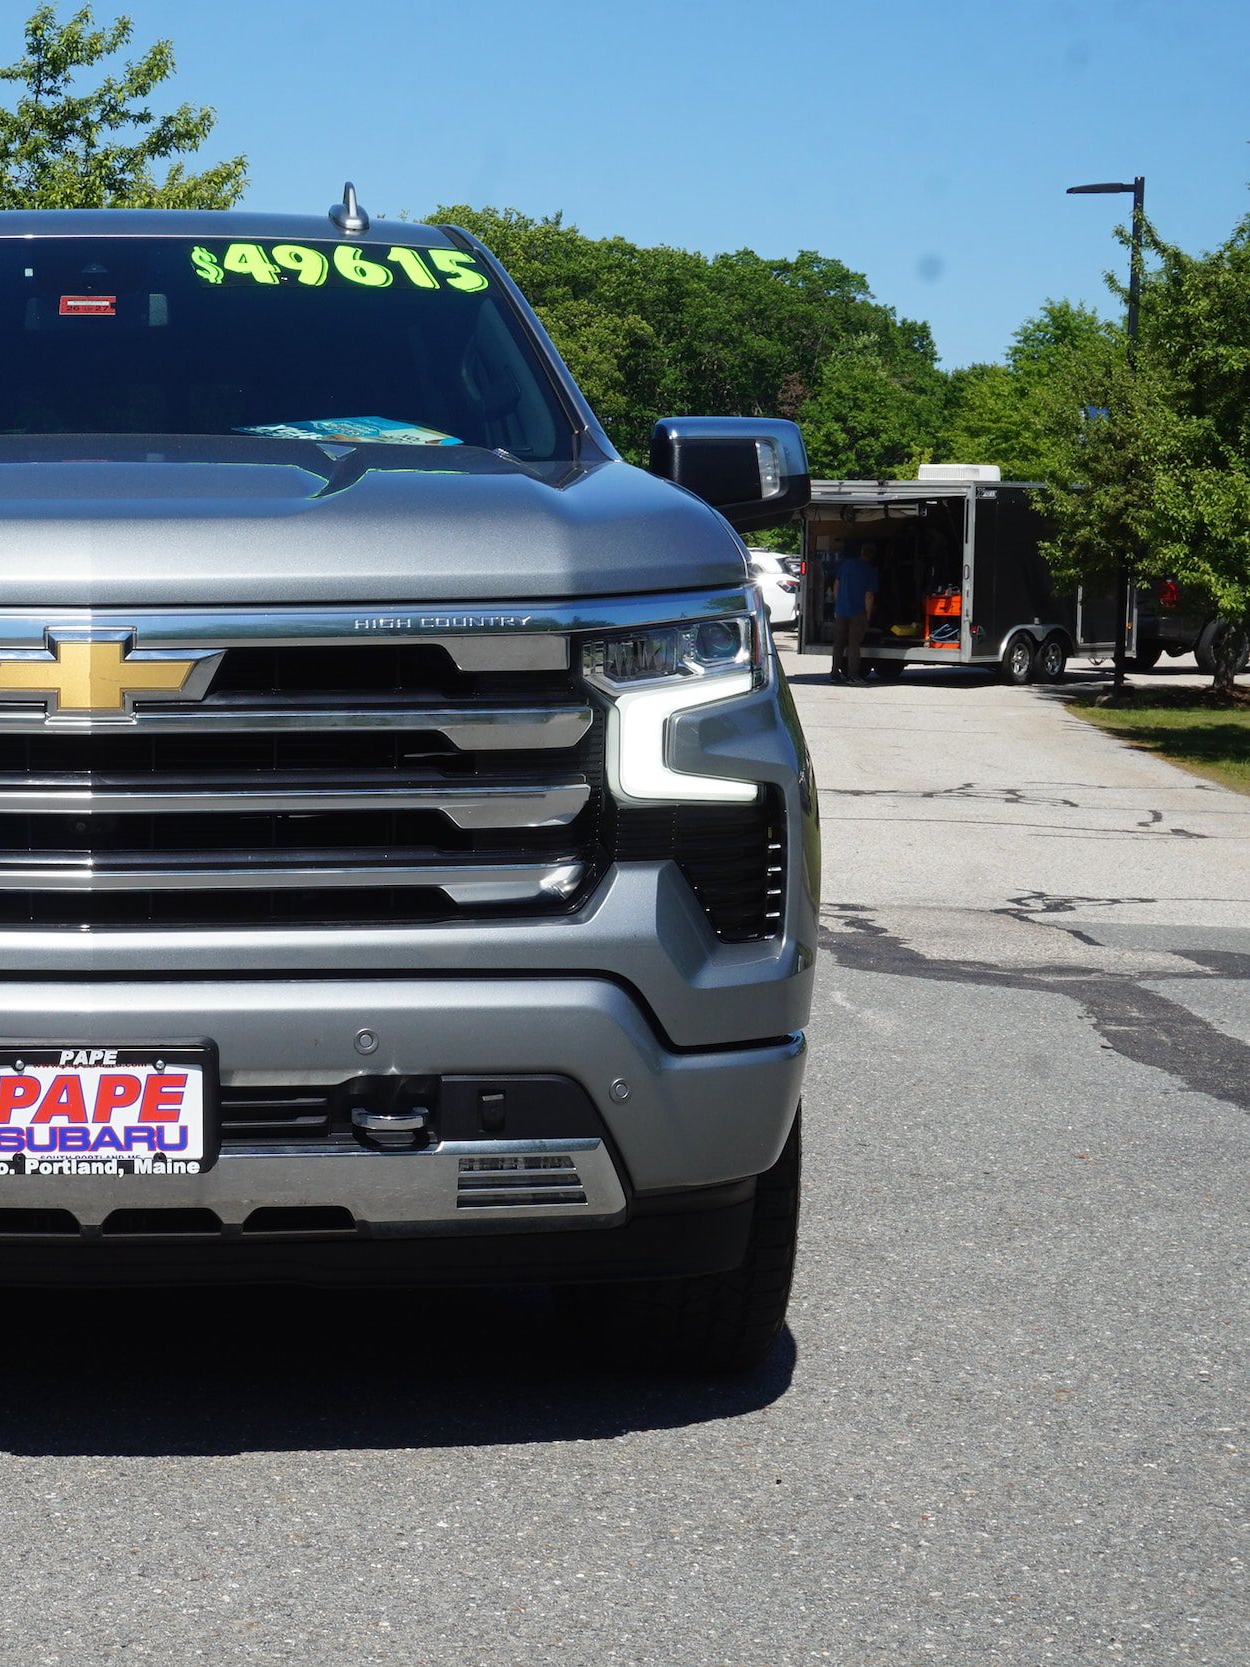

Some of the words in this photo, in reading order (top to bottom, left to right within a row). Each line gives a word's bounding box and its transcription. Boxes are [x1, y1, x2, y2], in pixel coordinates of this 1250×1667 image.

[191, 243, 489, 293] $49615
[355, 618, 411, 629] HIGH
[421, 615, 532, 628] COUNTRY
[59, 1050, 118, 1065] PAPE
[25, 1157, 125, 1178] Portland,
[134, 1157, 200, 1175] Maine
